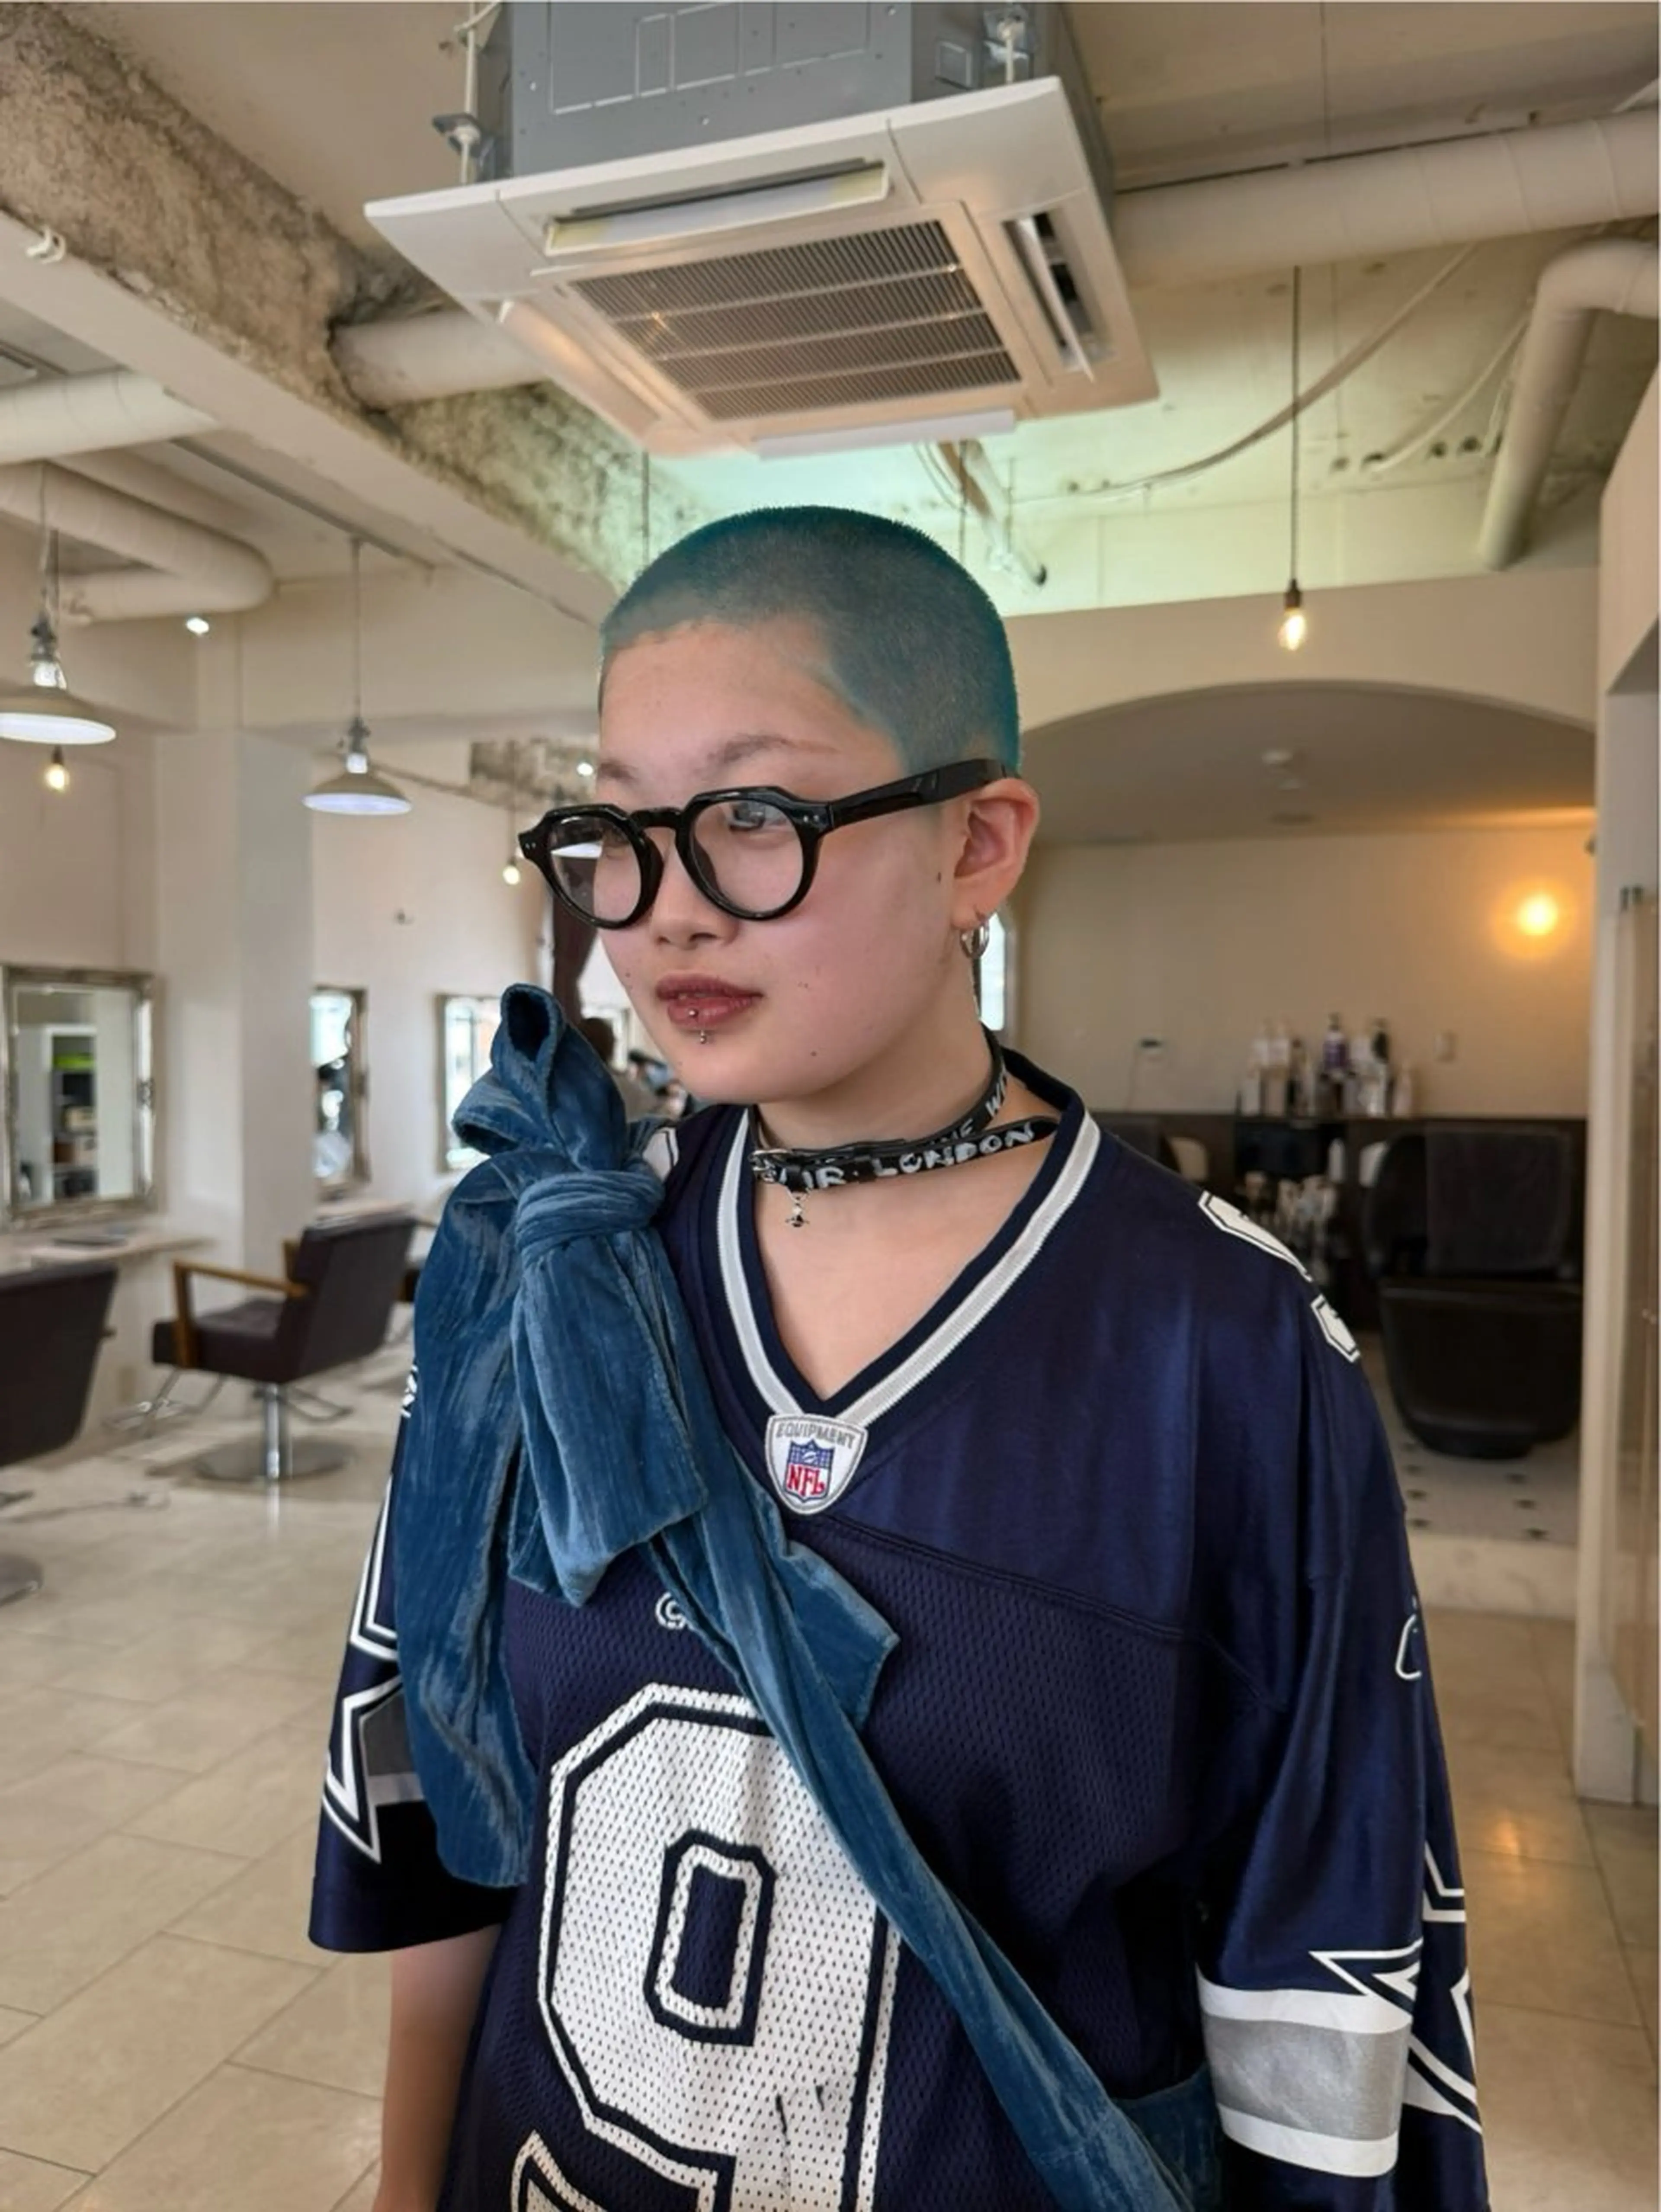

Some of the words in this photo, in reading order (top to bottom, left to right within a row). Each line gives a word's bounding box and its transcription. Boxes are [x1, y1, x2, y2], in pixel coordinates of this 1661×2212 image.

[870, 1122, 1035, 1177] LONDON
[776, 1423, 856, 1449] EQUIPMENT
[786, 1465, 826, 1497] NFL
